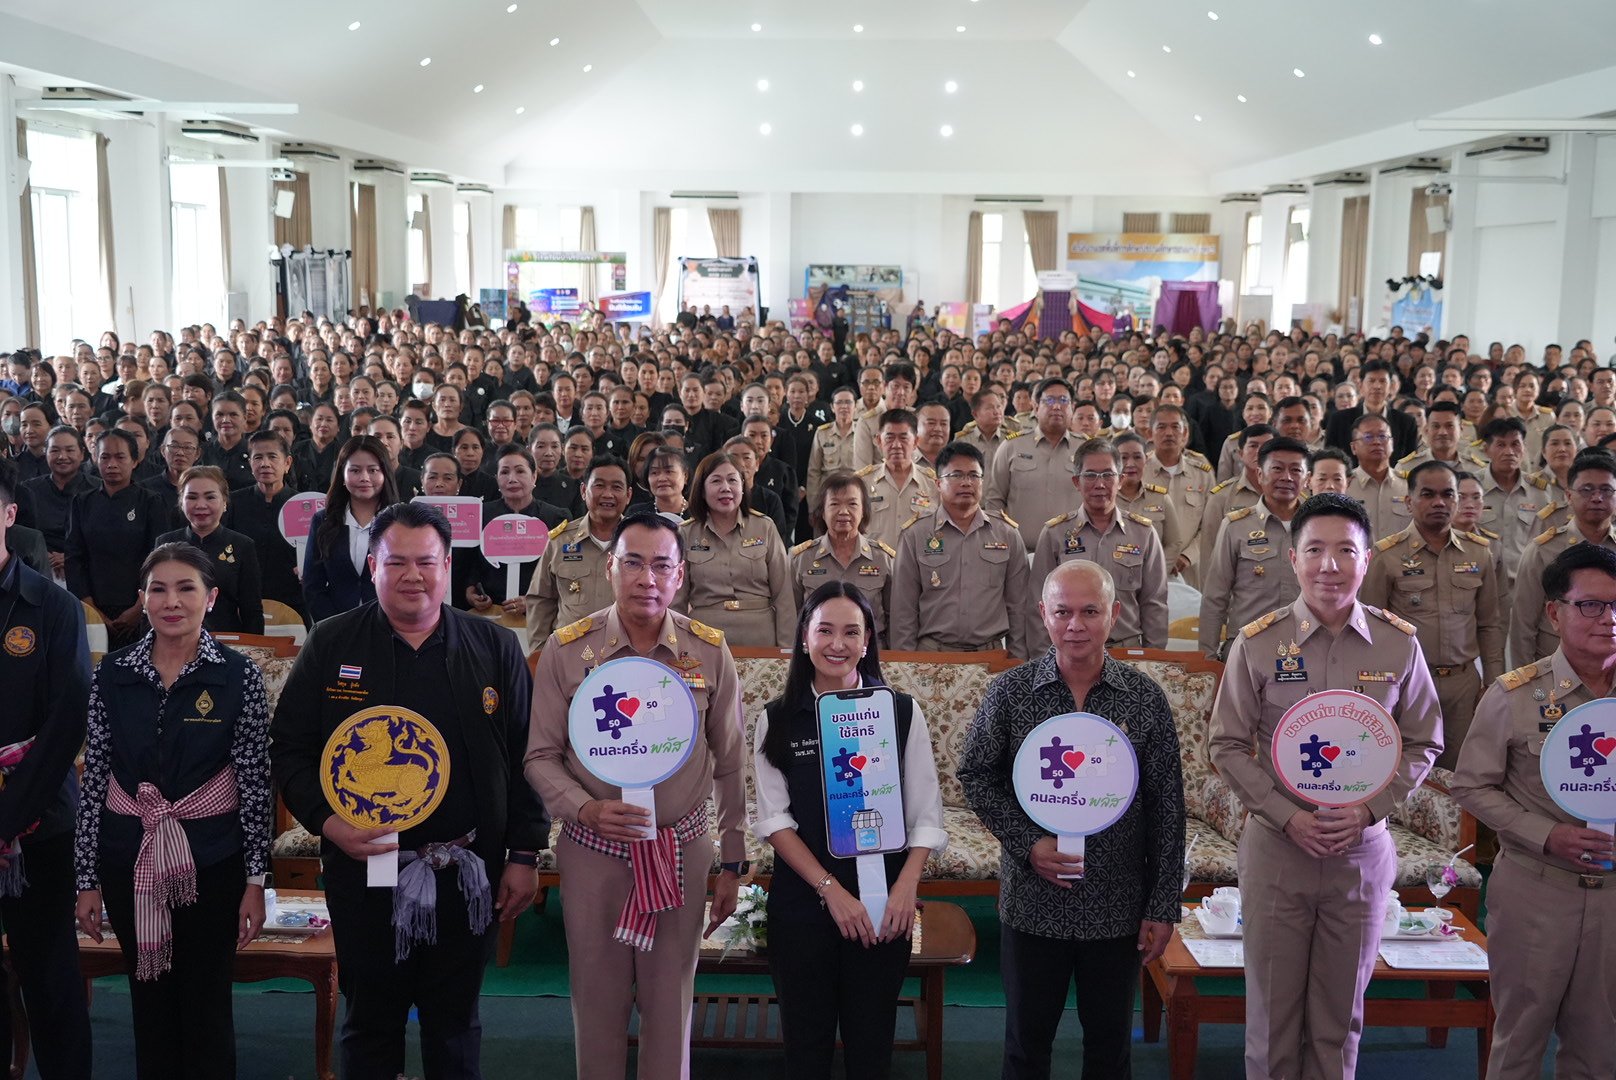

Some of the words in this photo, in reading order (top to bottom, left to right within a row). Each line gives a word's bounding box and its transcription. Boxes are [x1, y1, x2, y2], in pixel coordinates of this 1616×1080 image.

[647, 701, 658, 709] 50
[608, 719, 620, 727] 50
[831, 708, 880, 723] ขอนแก่น
[838, 724, 875, 739] ใช้สิทธิ
[1284, 703, 1336, 739] ขอนแก่น
[1338, 702, 1393, 748] เริ่มใช้สิทธิ
[589, 739, 647, 756] คนละครึ่ง
[650, 737, 690, 754] พลัส
[1582, 757, 1595, 765] 50
[829, 787, 870, 800] คนละครึ่ง
[871, 783, 898, 796] พลัส
[1297, 780, 1341, 791] คนละครึ่ง
[1343, 781, 1374, 792] พลัส
[1030, 791, 1086, 806] คนละครึ่ง
[1089, 793, 1127, 808] พลัส
